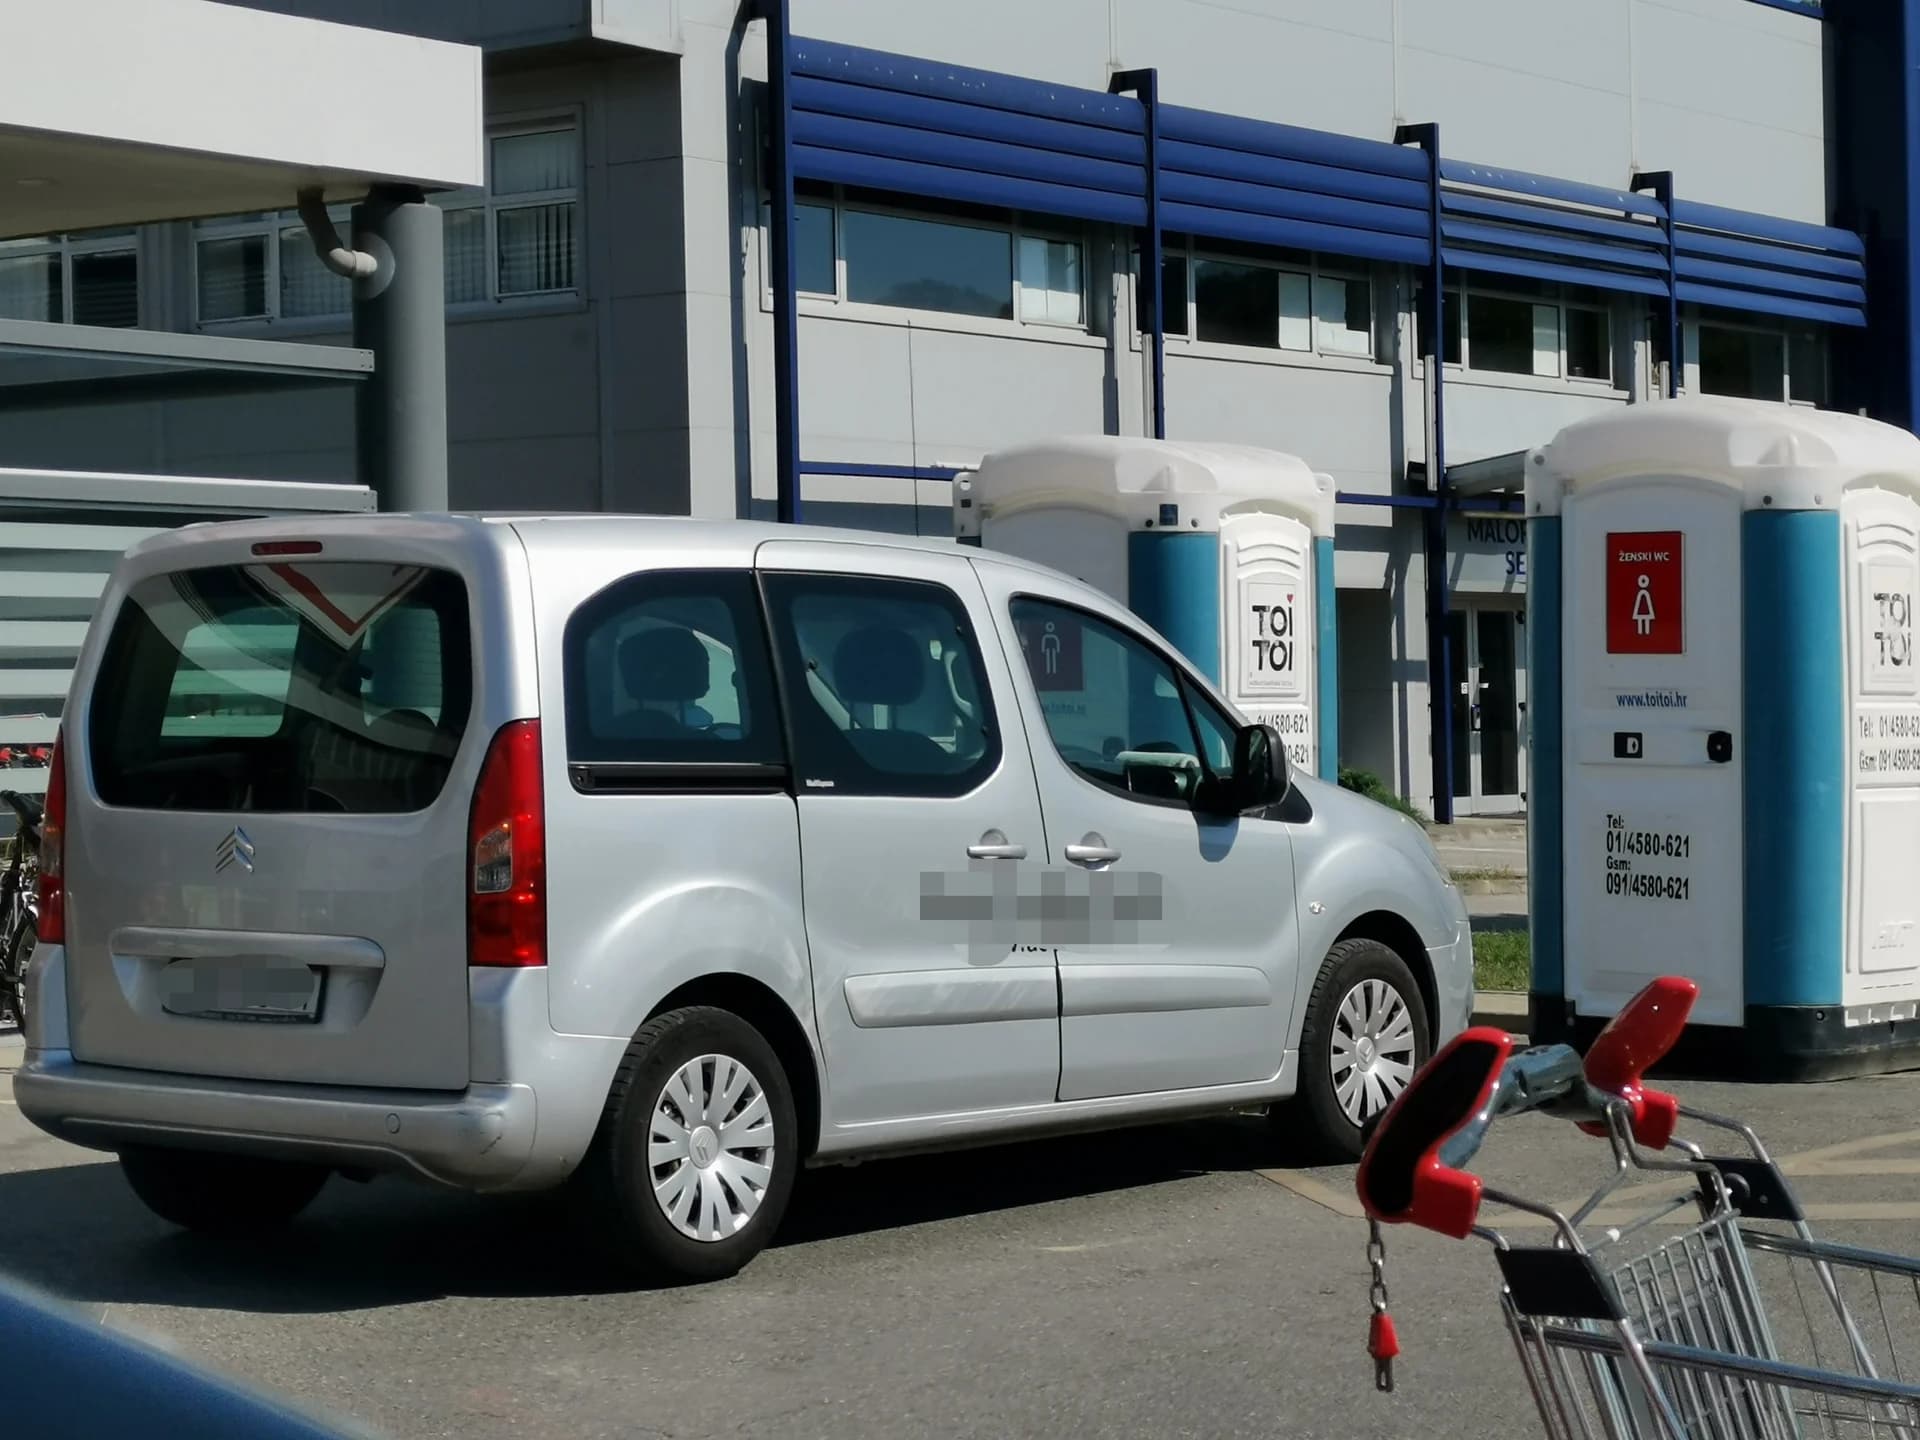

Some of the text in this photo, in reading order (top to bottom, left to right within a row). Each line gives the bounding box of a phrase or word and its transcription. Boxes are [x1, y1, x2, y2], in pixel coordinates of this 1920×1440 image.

[1619, 549, 1670, 562] ŽENSKI WC
[1252, 605, 1293, 637] TOI
[1252, 640, 1293, 671] TOI
[1616, 691, 1687, 707] www.toitoi.hr
[1606, 814, 1624, 829] Tel:
[1606, 830, 1689, 858] 01/4580-621
[1606, 855, 1631, 870] Gsm:
[1606, 872, 1689, 900] 091/4580-621
